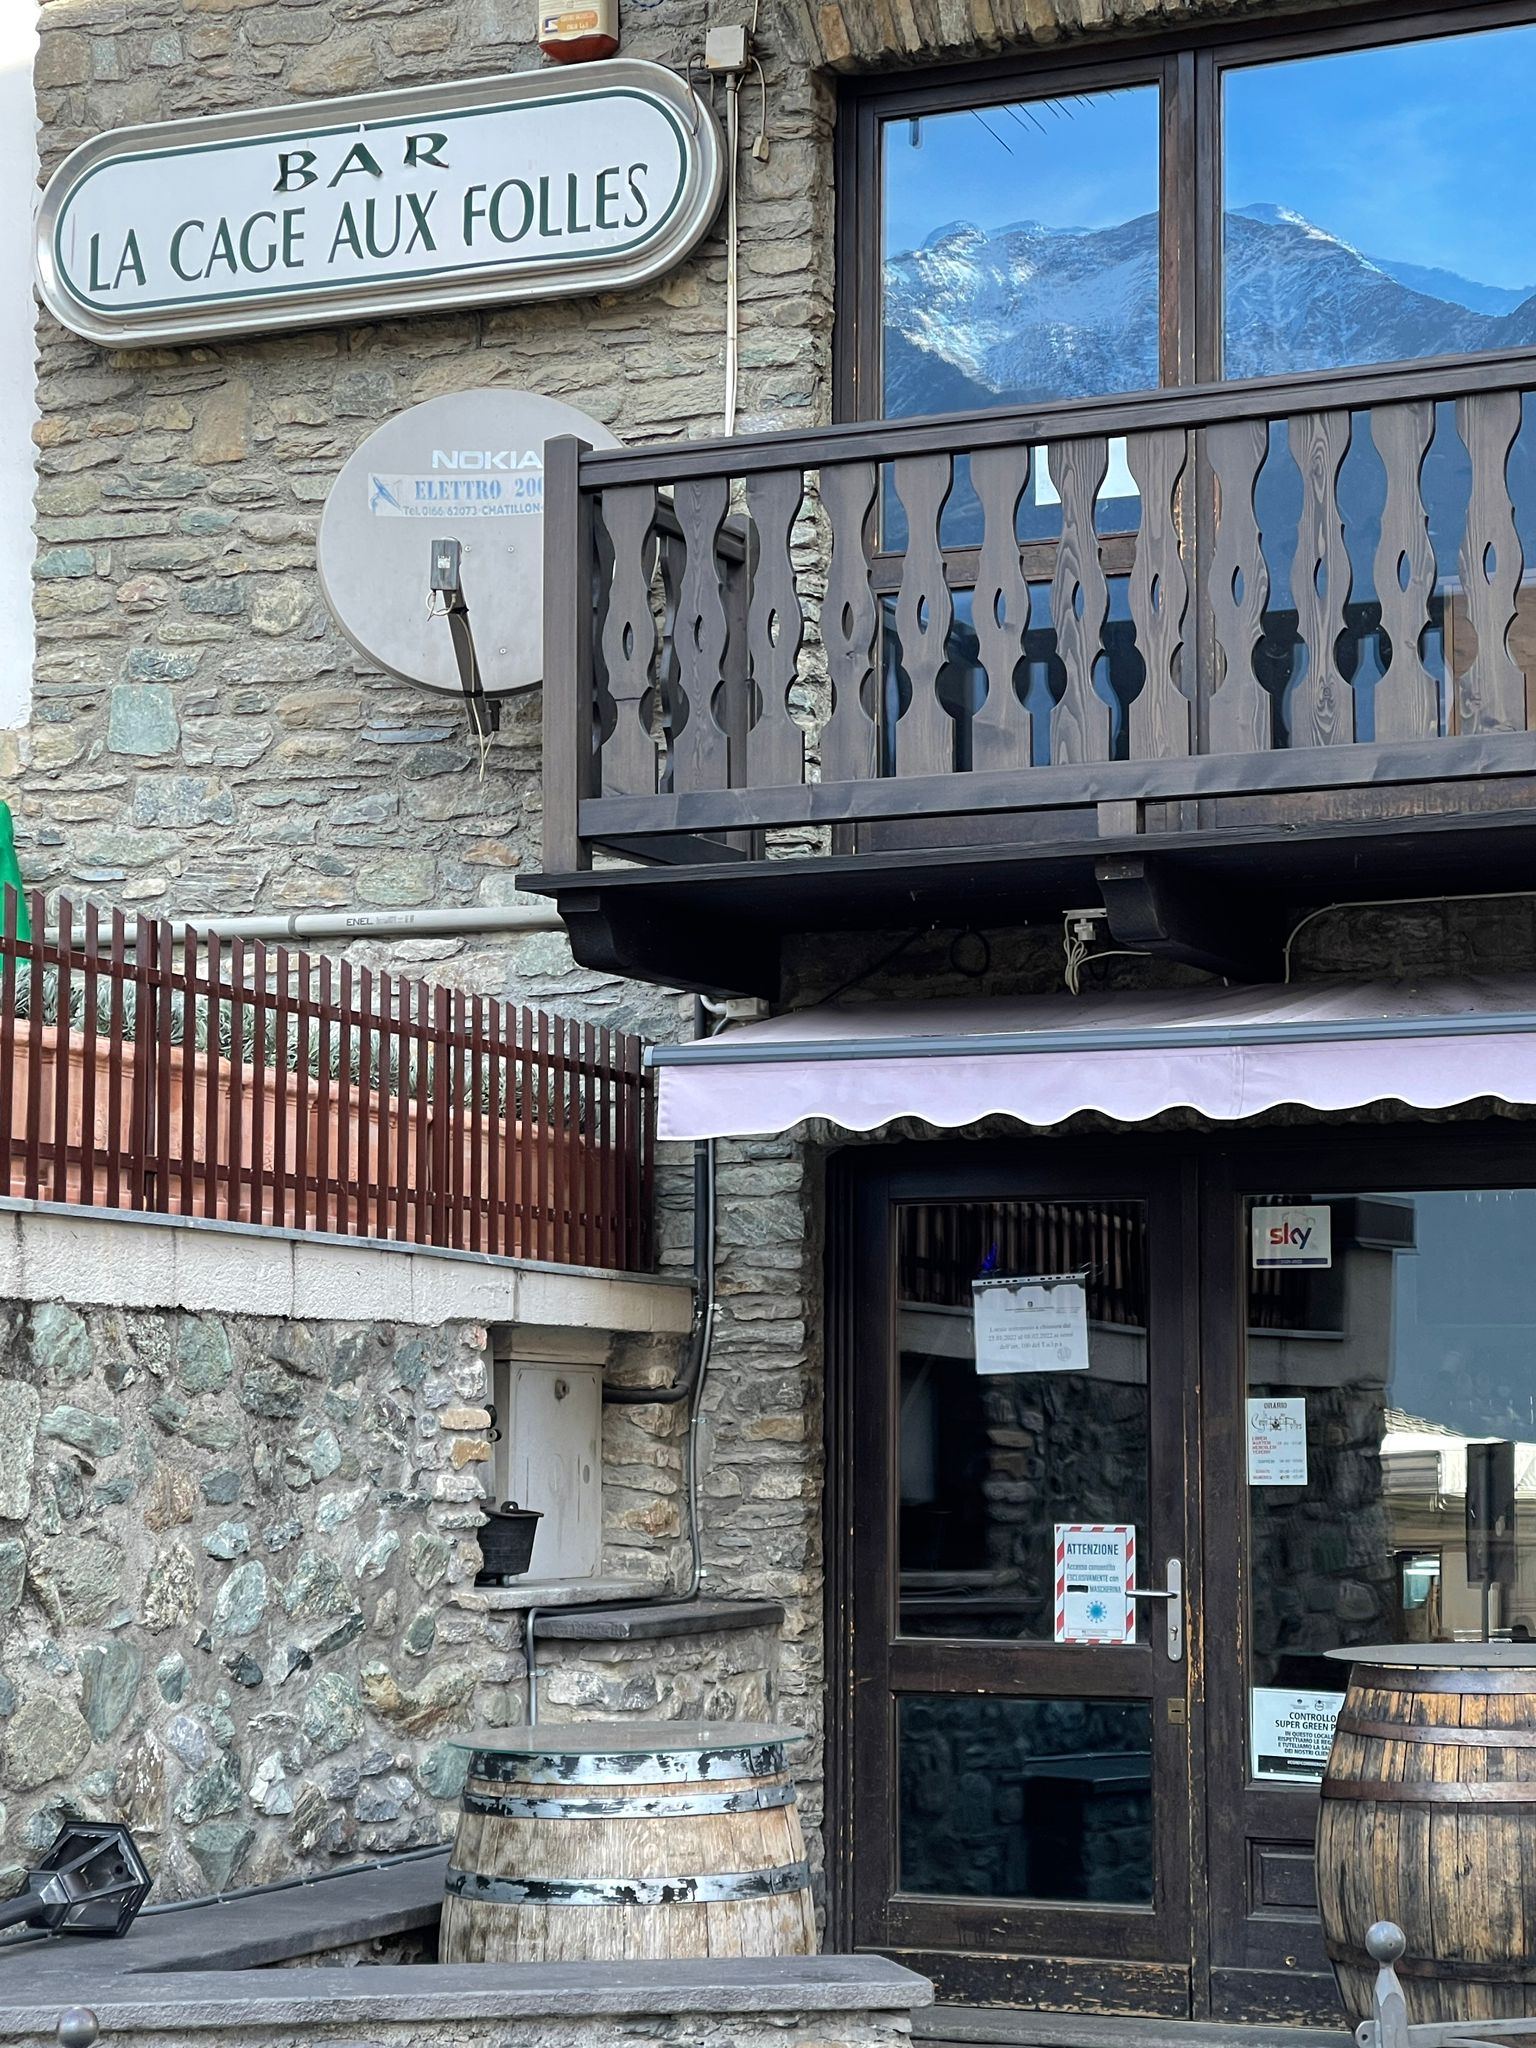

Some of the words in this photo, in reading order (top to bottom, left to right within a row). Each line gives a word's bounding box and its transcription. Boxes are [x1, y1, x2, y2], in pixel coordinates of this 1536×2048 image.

[273, 132, 449, 192] BAR
[88, 228, 146, 291] LA
[169, 207, 304, 281] CAGE
[328, 190, 437, 263] AUX
[463, 163, 647, 246] FOLLES
[432, 450, 543, 469] NOKIA
[415, 480, 501, 500] ELETTRO
[446, 505, 477, 516] 62073
[346, 918, 373, 926] ENEL
[1270, 1222, 1312, 1250] sky
[1067, 1543, 1119, 1556] ATTENZIONE
[1275, 1720, 1300, 1729] SUPER
[1302, 1721, 1328, 1731] GREEN
[1289, 1712, 1337, 1723] CONTROLLO
